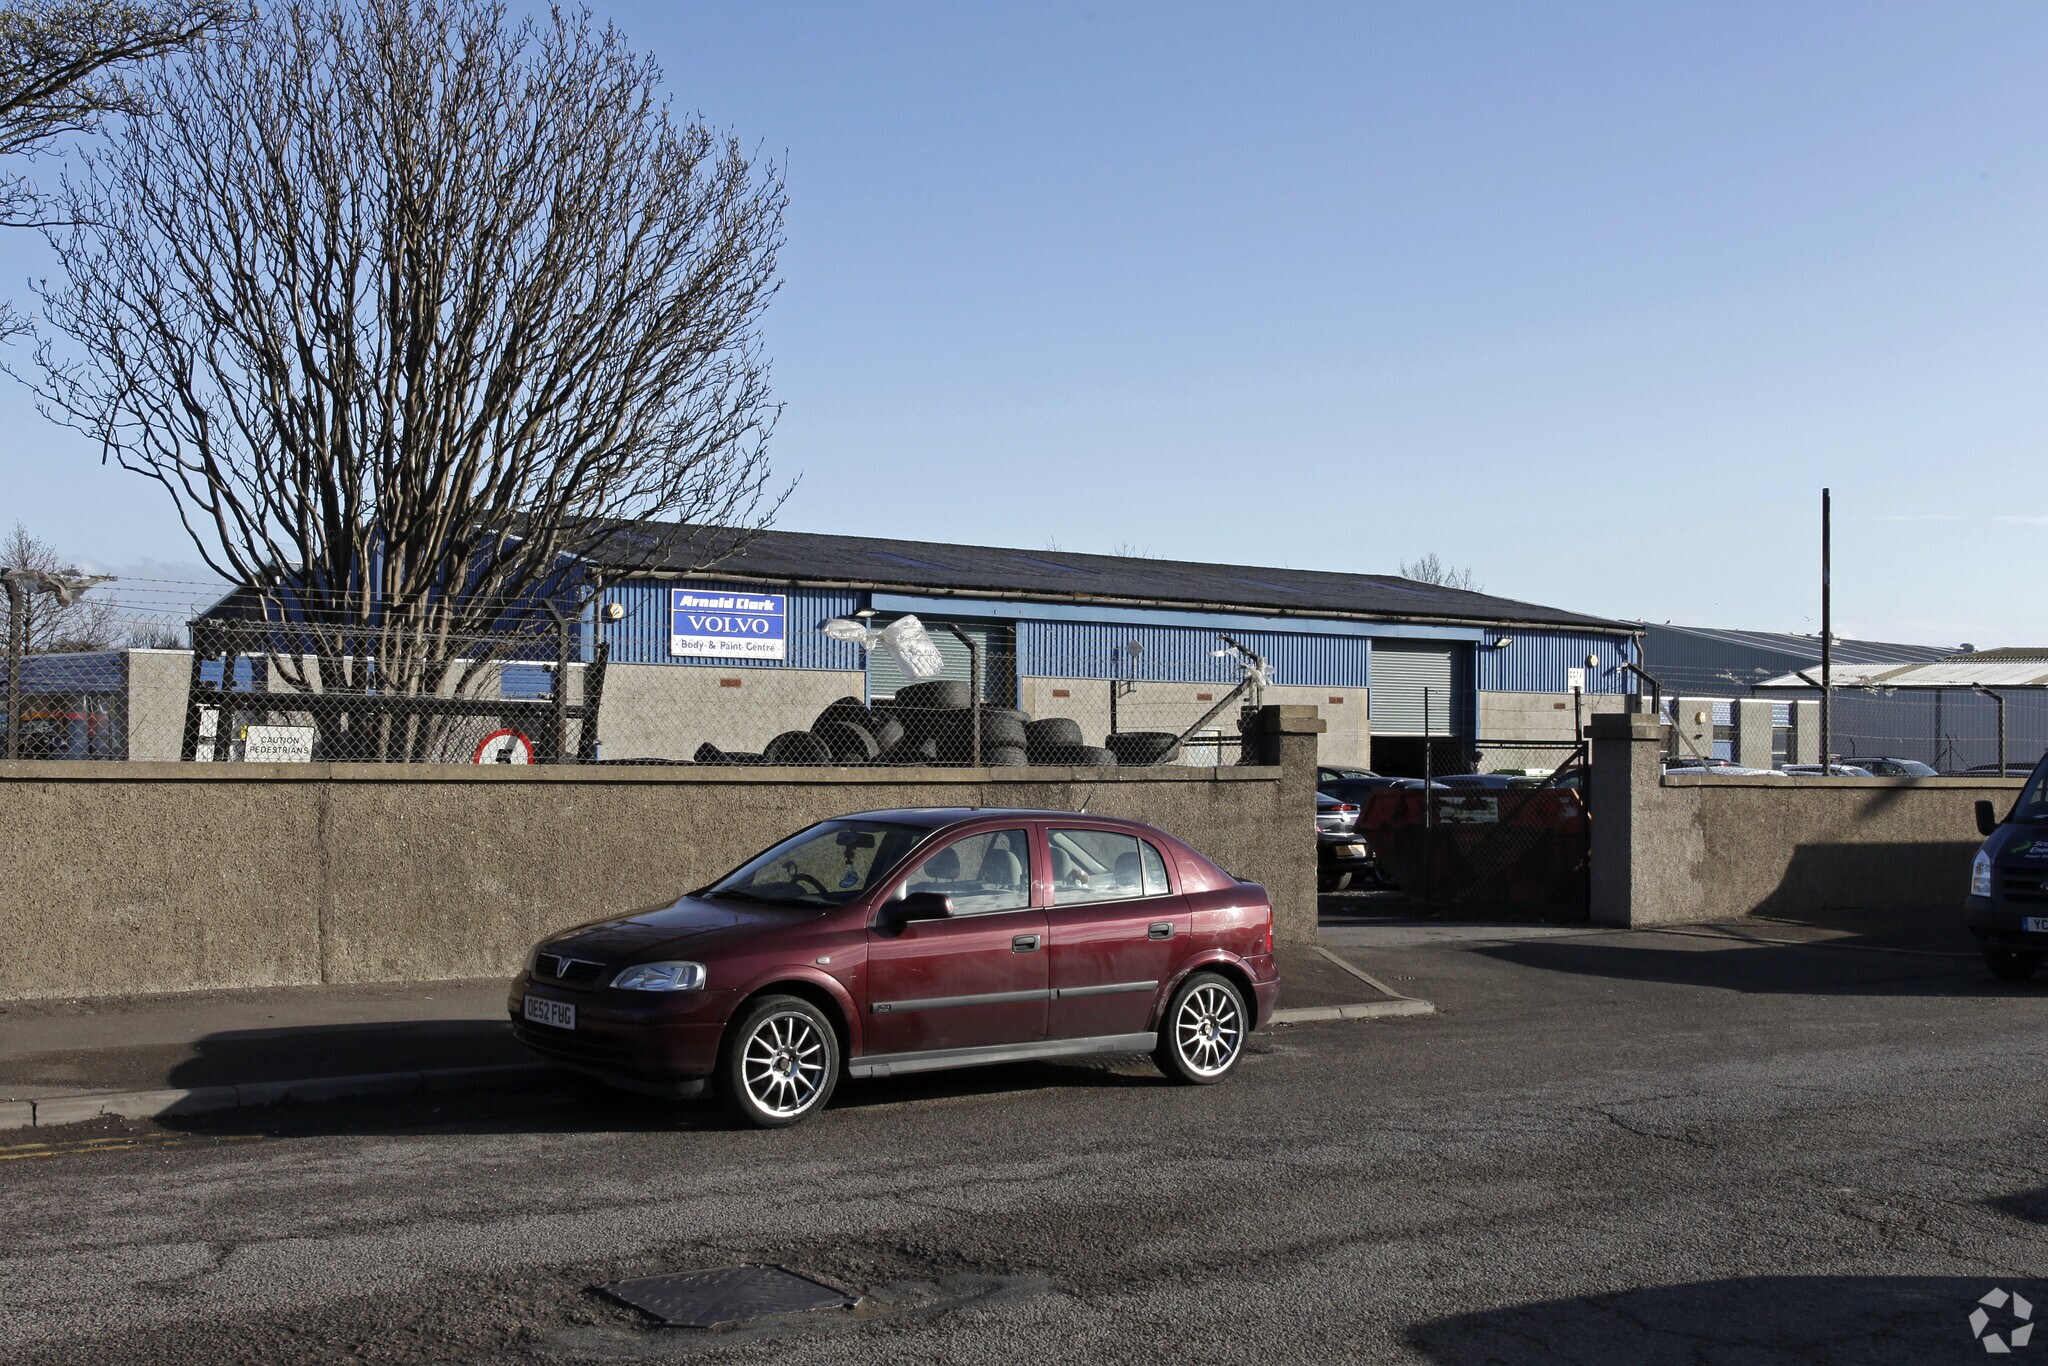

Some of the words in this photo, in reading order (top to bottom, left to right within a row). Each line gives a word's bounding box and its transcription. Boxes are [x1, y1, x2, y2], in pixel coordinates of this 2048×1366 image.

[680, 595, 734, 609] Arnold
[736, 598, 775, 611] Clark
[688, 615, 769, 634] VOLVO
[681, 640, 704, 652] Body
[708, 641, 716, 650] &
[720, 641, 742, 651] Paint
[746, 642, 775, 652] Centre
[261, 736, 299, 744] CAUTION
[249, 745, 309, 754] PEDESTRIANS
[528, 998, 550, 1020] OE52
